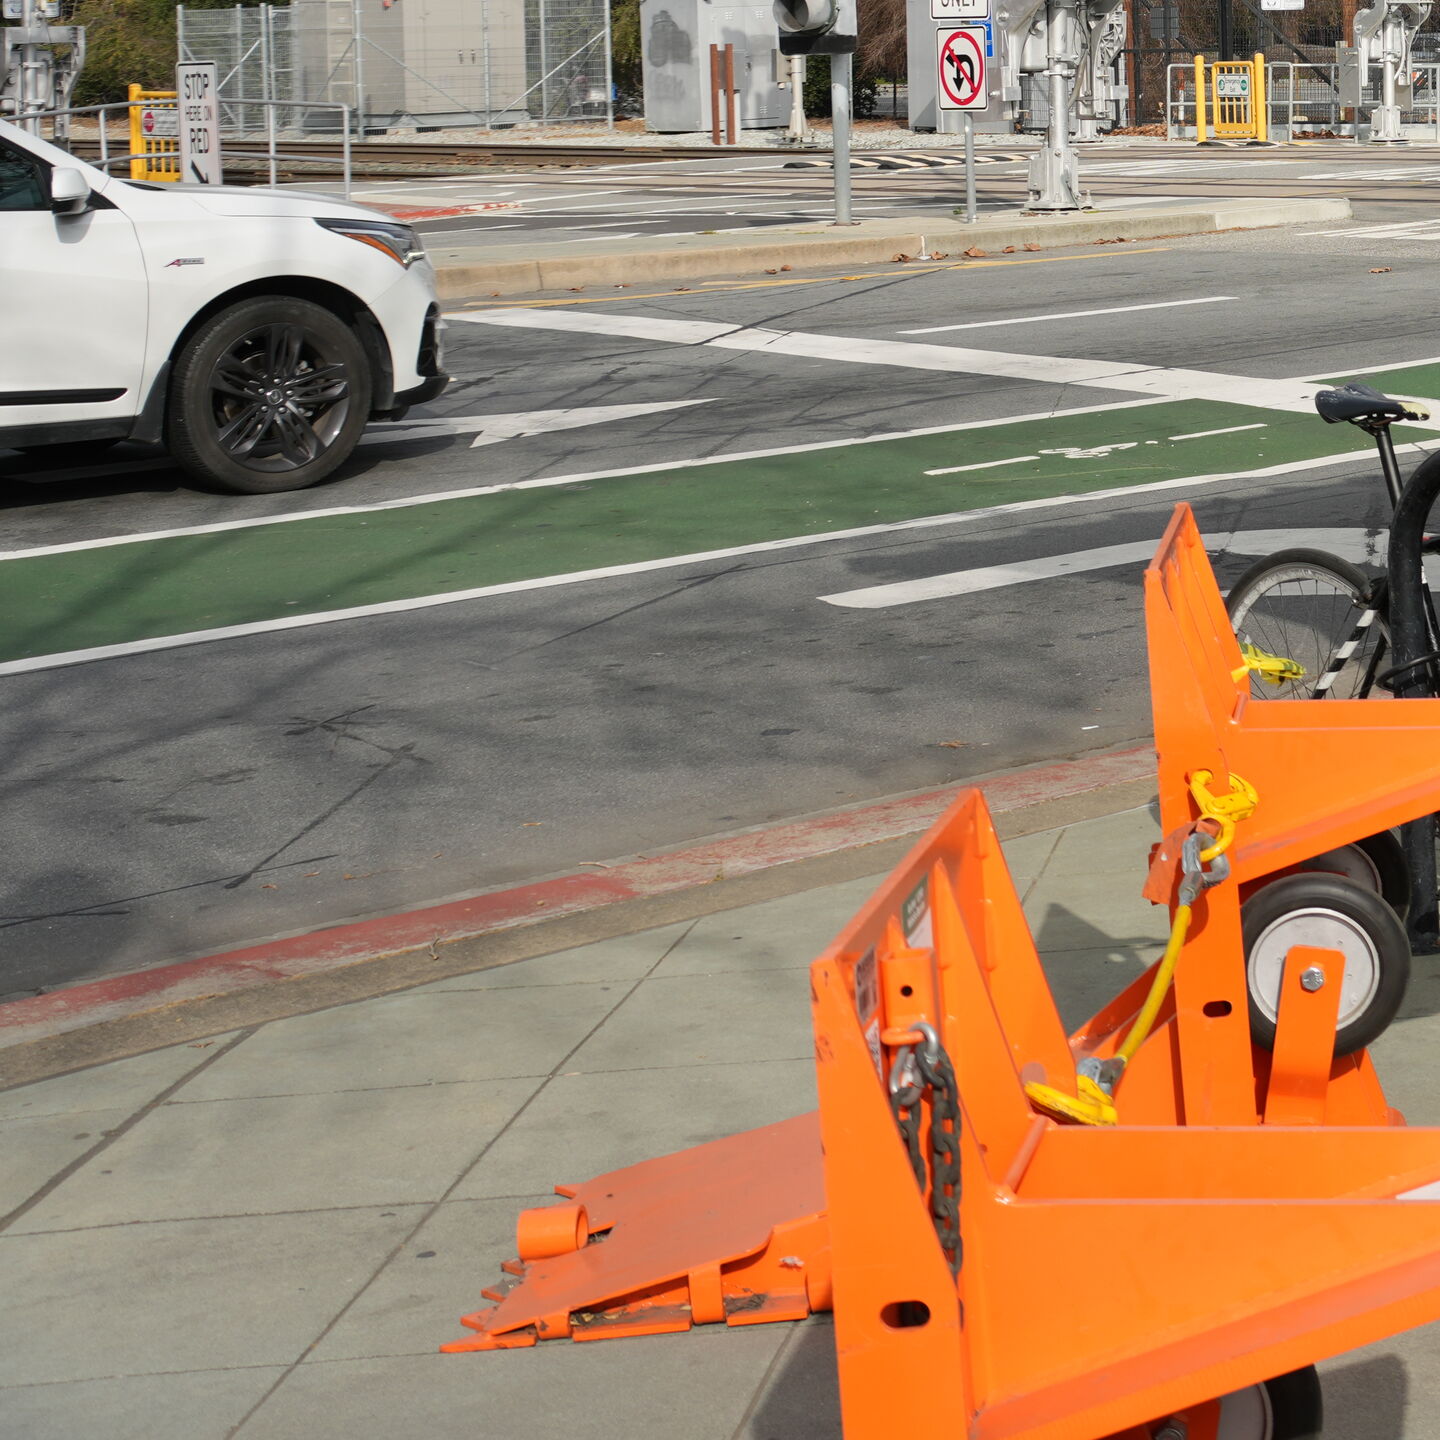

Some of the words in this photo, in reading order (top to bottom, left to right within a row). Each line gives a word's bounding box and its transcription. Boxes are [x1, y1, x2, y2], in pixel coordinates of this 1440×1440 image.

[185, 73, 209, 99] STOP
[185, 105, 201, 121] HERE
[190, 128, 210, 154] RED
